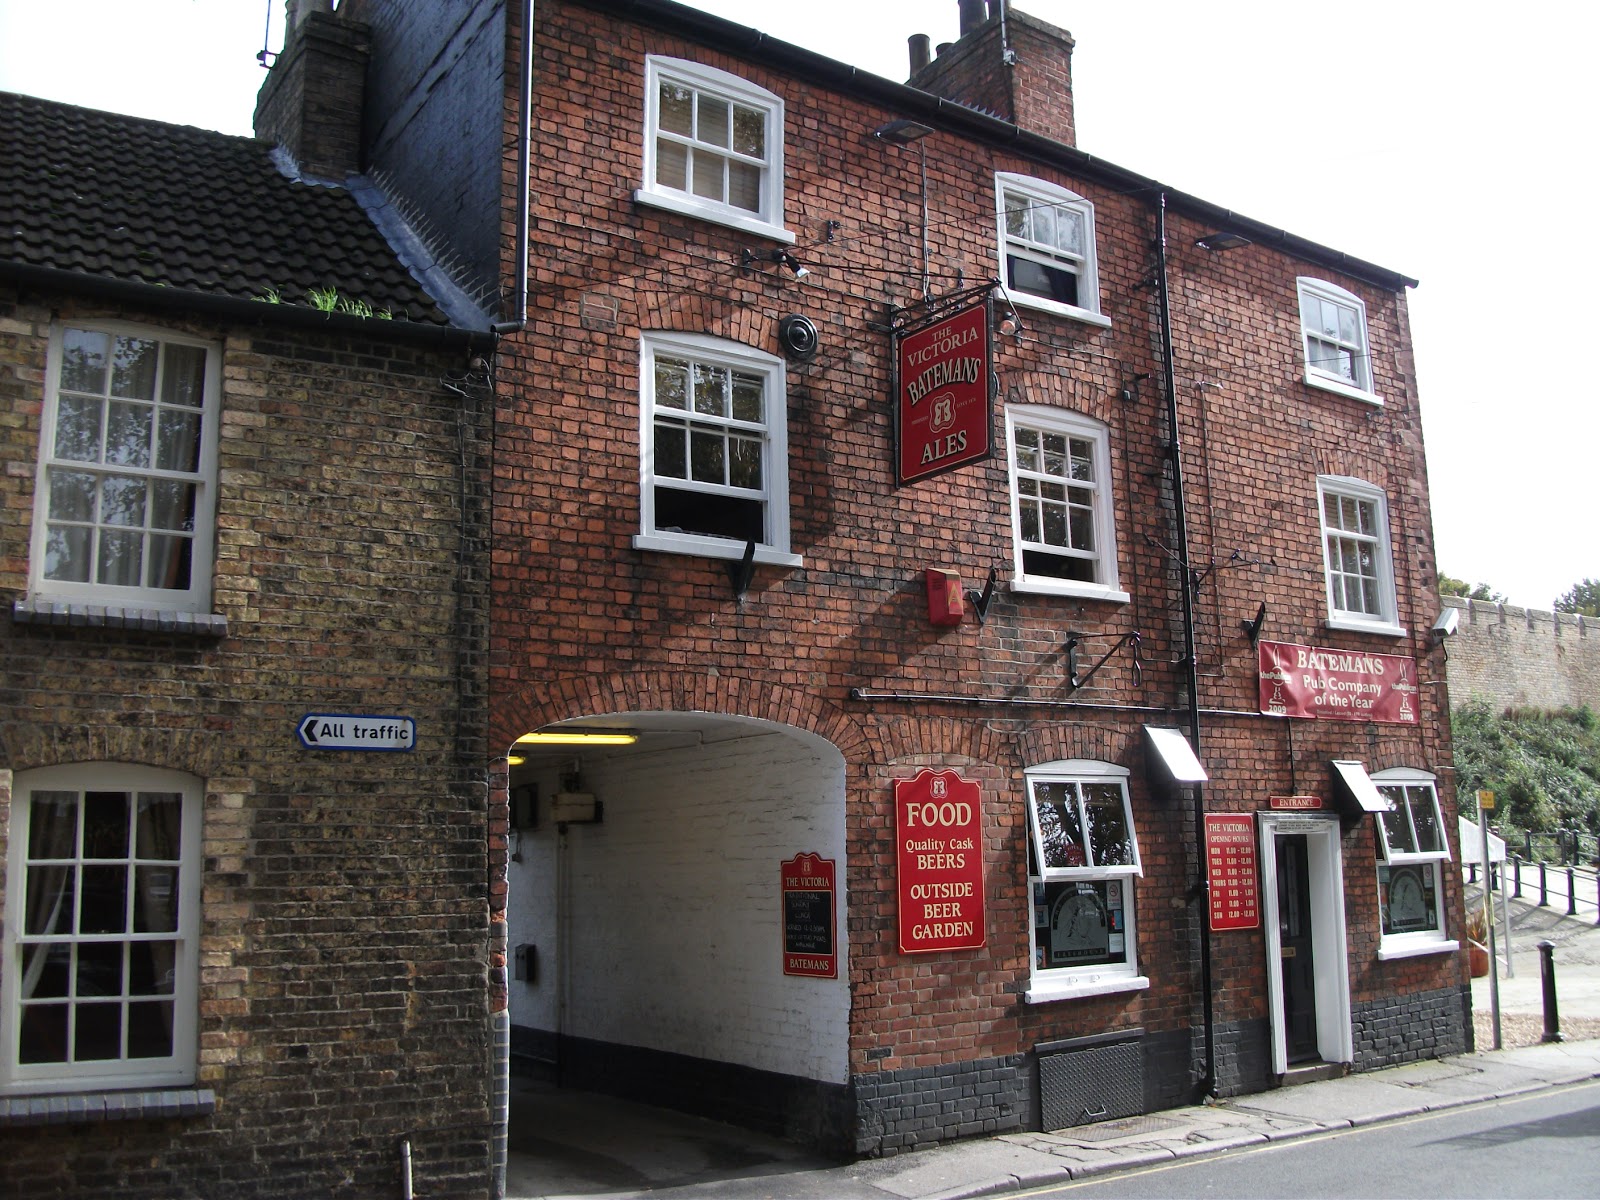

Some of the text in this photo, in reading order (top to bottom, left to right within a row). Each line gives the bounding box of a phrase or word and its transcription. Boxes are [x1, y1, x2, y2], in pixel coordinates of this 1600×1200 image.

[932, 326, 952, 342] THE
[907, 327, 979, 367] VICTORIA
[907, 357, 981, 405] BATEMANS
[920, 430, 967, 464] ALES
[1297, 650, 1384, 675] BATEMANS
[1303, 675, 1382, 697] Pub Company
[1314, 693, 1374, 709] of the Year
[1269, 705, 1287, 713] 2009
[1400, 713, 1414, 721] 2009
[320, 723, 409, 740] All traffic
[1280, 799, 1314, 807] ENTRANCE
[906, 802, 972, 827] FOOD
[1208, 823, 1249, 832] THE VICTORIA
[906, 837, 974, 853] Quality Cask
[1210, 835, 1249, 843] OPENING HOURS
[1210, 847, 1221, 855] MON
[917, 853, 966, 870] BEERS
[1211, 857, 1222, 865] TUES
[1212, 868, 1221, 876] WED
[786, 877, 829, 887] THE VICTORIA
[1212, 879, 1226, 887] THURS
[910, 882, 974, 899] OUTSIDE
[1212, 890, 1220, 898] FRI
[924, 902, 962, 919] BEER
[1213, 900, 1221, 908] SAT
[1213, 911, 1223, 919] SUN
[912, 921, 974, 940] GARDEN
[789, 958, 829, 971] BATEMANS
